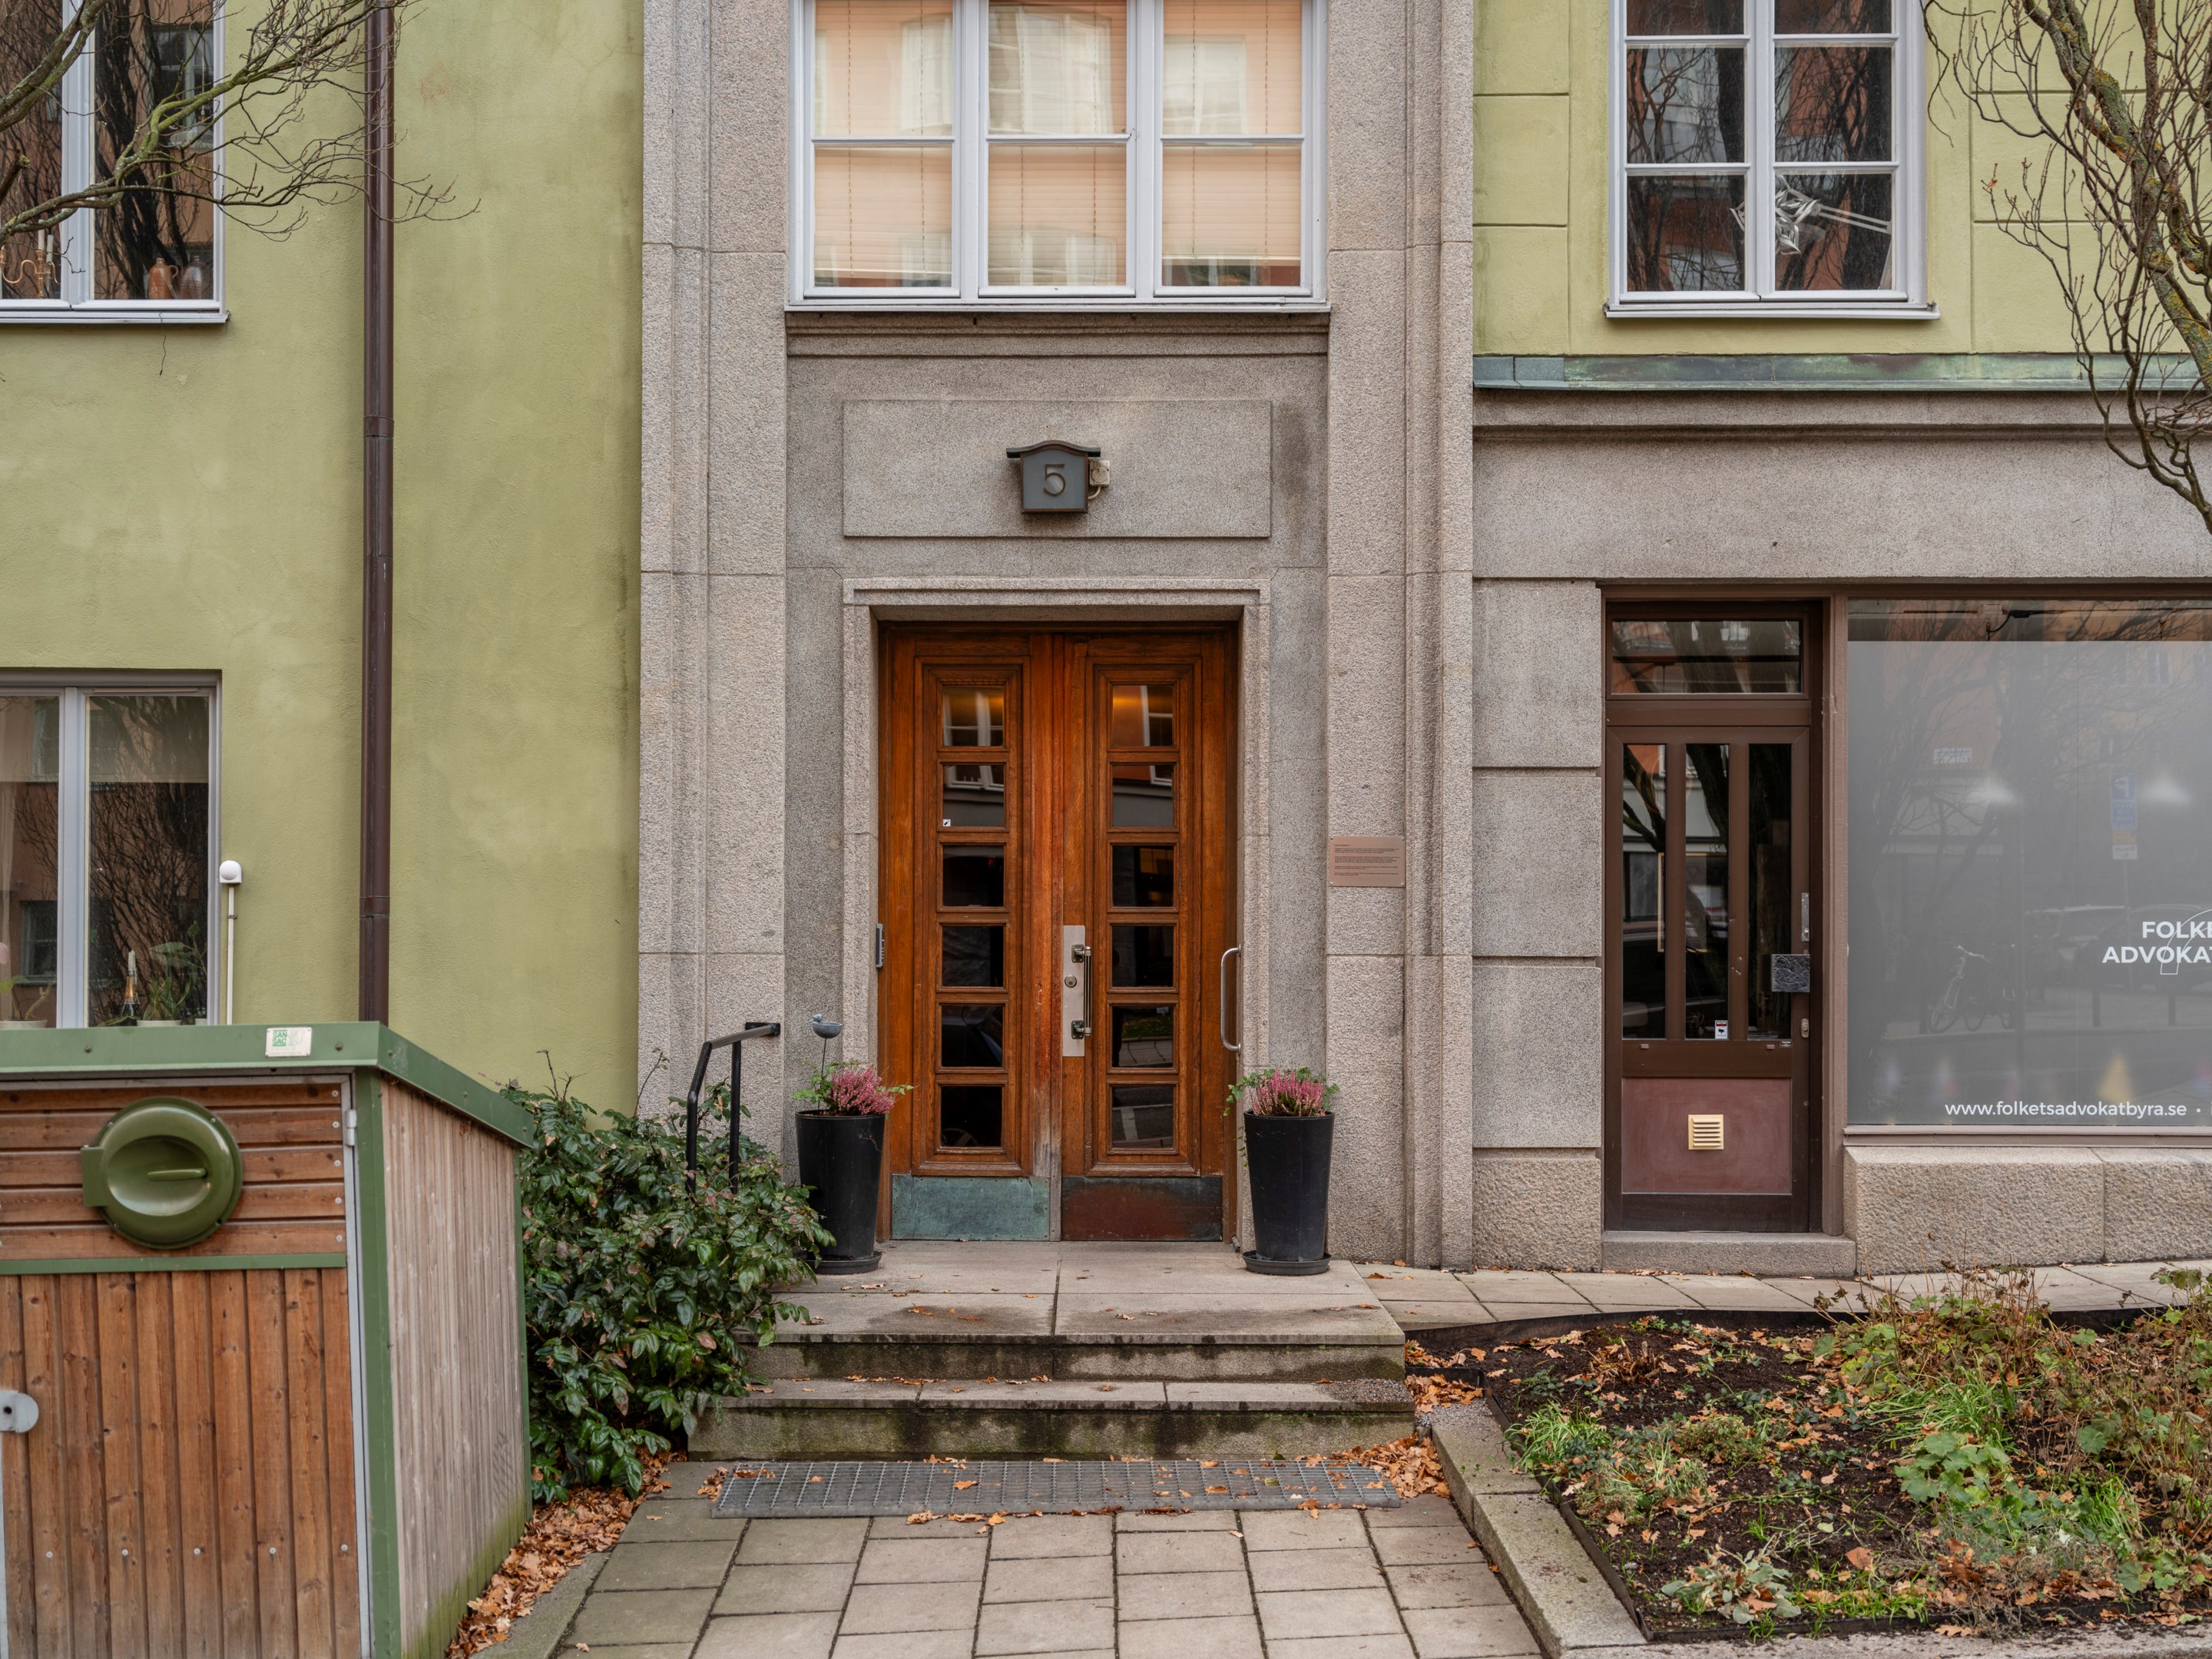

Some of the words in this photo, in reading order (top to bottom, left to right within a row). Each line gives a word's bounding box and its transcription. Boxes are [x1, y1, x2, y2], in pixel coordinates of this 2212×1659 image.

[1042, 463, 1066, 497] 5
[2101, 945, 2212, 964] ADVOKA
[1944, 1101, 2187, 1119] www.folketsadvokatbyra.se
